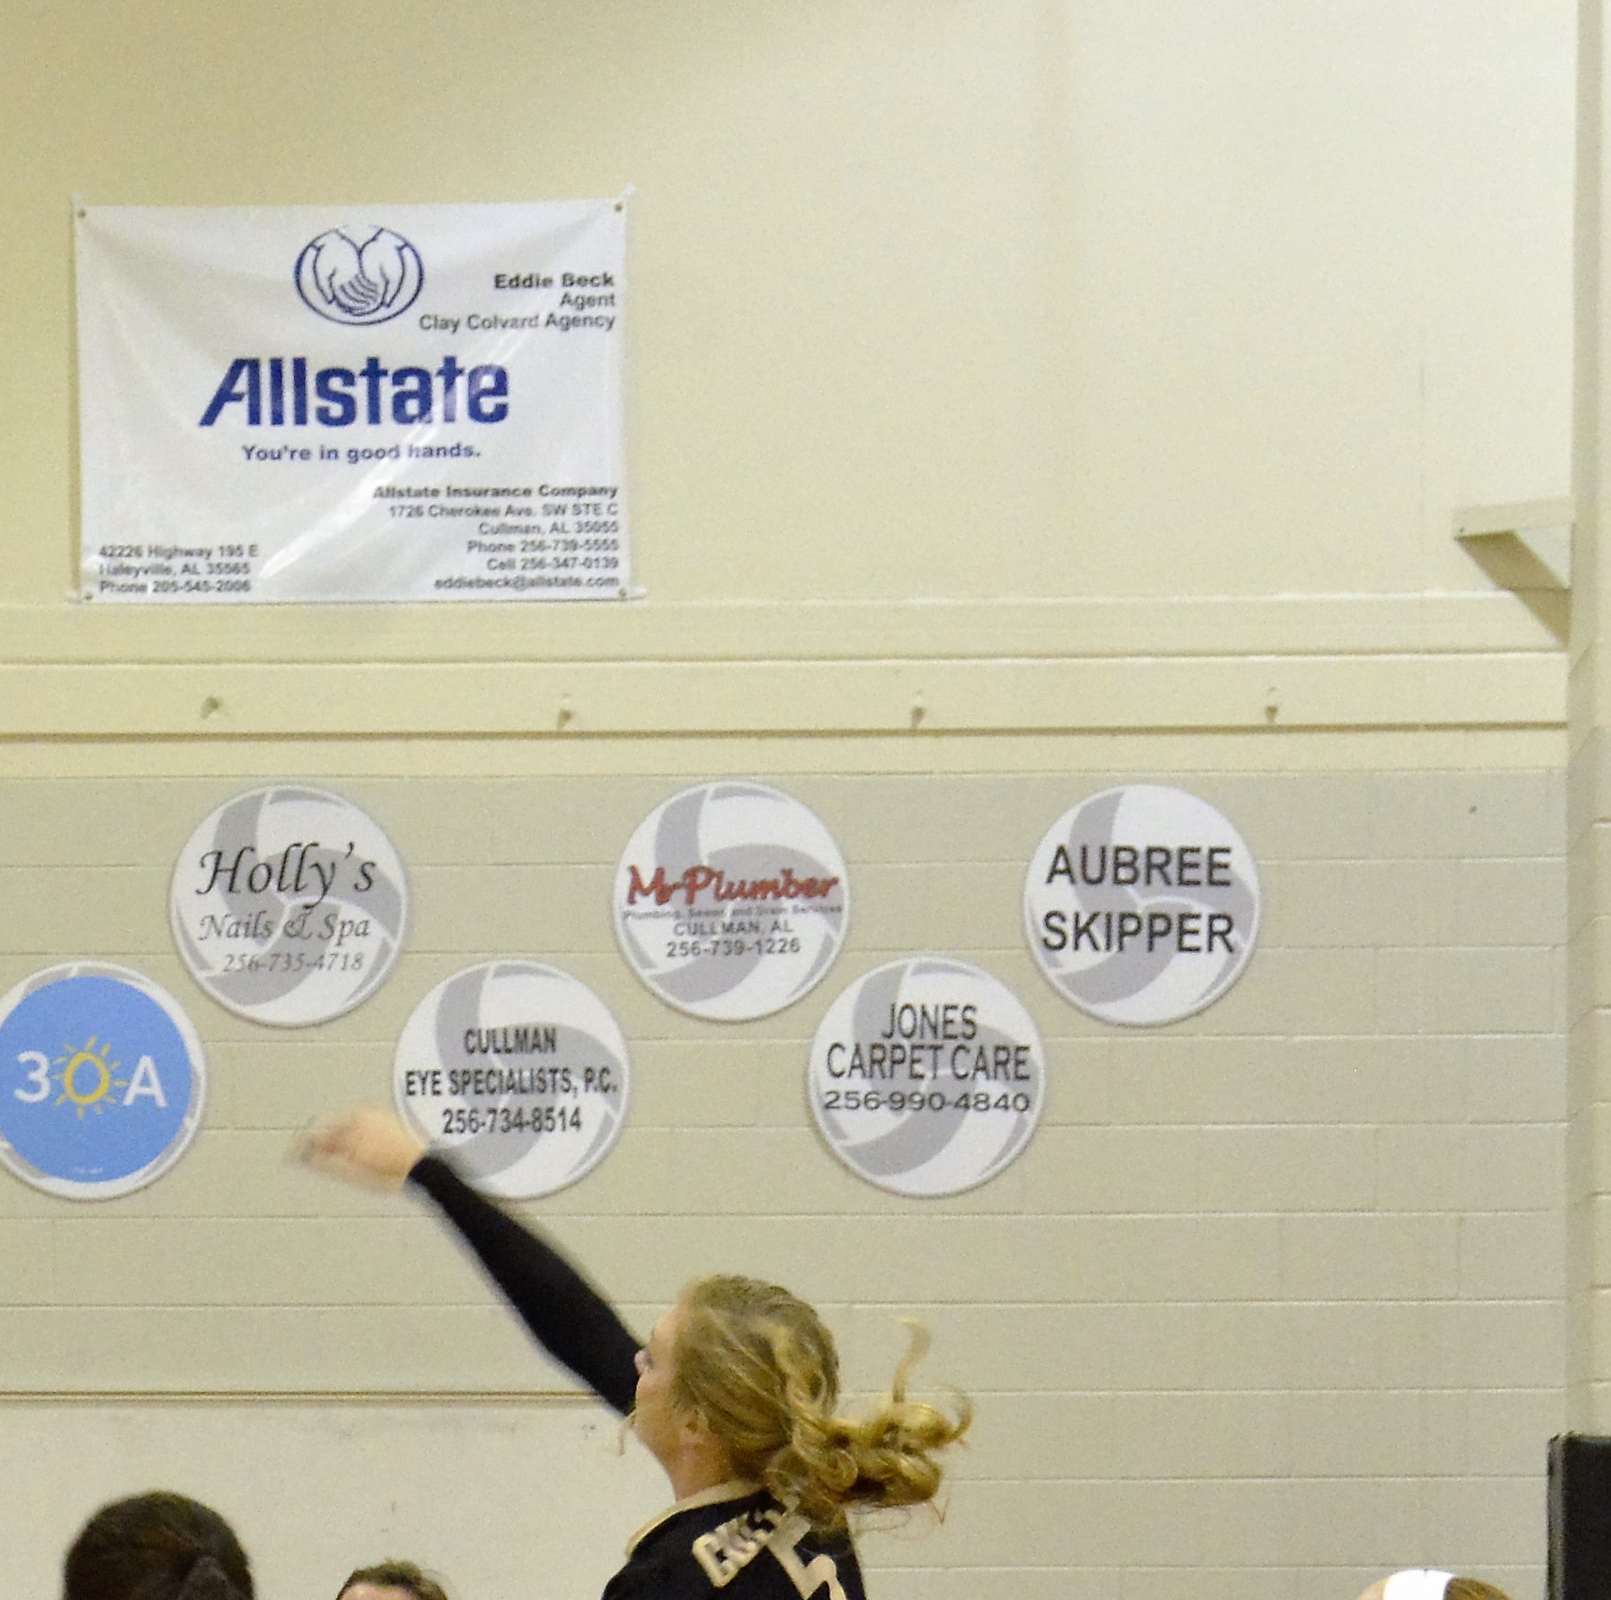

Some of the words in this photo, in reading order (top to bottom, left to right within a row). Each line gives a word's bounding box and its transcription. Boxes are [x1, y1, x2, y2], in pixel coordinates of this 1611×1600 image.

[494, 273, 553, 289] Eddie
[561, 272, 614, 287] Beck
[560, 293, 615, 310] Agent
[419, 314, 460, 334] Clay
[467, 313, 540, 330] Colvard
[545, 312, 616, 331] Agency
[198, 355, 508, 427] Allstate
[241, 444, 311, 461] You're
[320, 444, 340, 460] in
[347, 444, 401, 463] good
[407, 442, 481, 458] hands.
[373, 485, 440, 498] Allstate
[446, 485, 532, 497] Insurance
[538, 483, 618, 499] Company
[428, 504, 500, 517] Cherokee
[549, 521, 569, 534] AL
[148, 544, 213, 560] Highway
[249, 543, 259, 557] E
[467, 540, 516, 552] Phone
[181, 562, 201, 575] AL
[487, 557, 516, 571] Cell
[195, 841, 377, 909] Holly's
[1046, 846, 1232, 886] AUBREE
[197, 910, 275, 942] Nails
[283, 907, 314, 940] &
[318, 912, 370, 947] Spa
[770, 919, 794, 933] AL
[1042, 912, 1235, 953] SKIPPER
[223, 952, 364, 973] 256-735-4718
[881, 1004, 977, 1041] JONES
[464, 1027, 557, 1054] CULLMAN
[827, 1042, 945, 1080] CARPET
[950, 1043, 1030, 1081] CARE
[405, 1070, 442, 1096] EYE
[448, 1067, 578, 1098] SPECIALISTS,
[584, 1065, 618, 1093] P.C.
[442, 1106, 583, 1134] 256-734-8514
